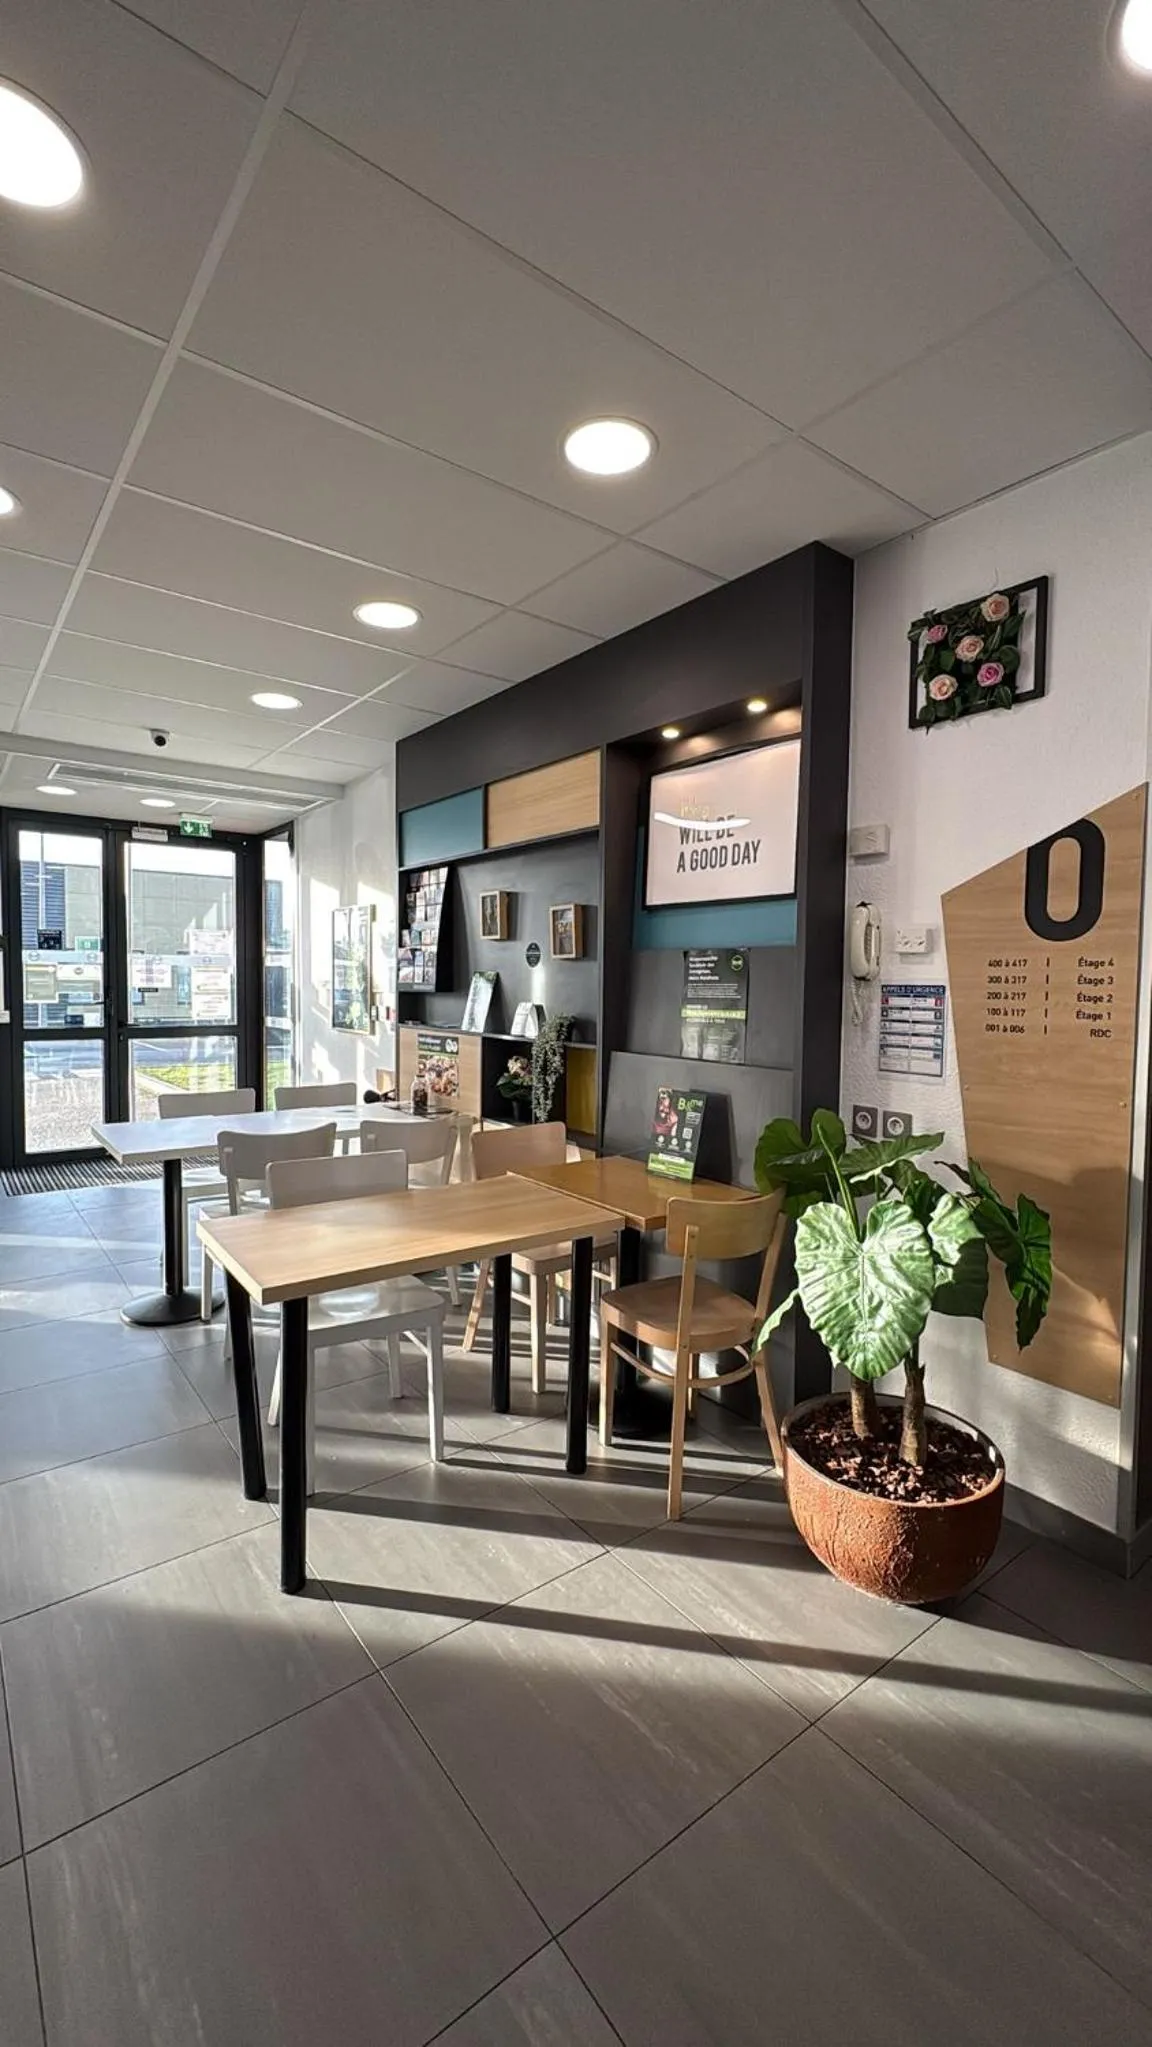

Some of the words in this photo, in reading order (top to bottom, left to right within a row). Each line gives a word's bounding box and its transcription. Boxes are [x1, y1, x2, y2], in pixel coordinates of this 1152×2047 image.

[679, 819, 712, 845] WILL
[676, 851, 686, 873] A
[690, 845, 728, 871] GOOD
[731, 839, 761, 866] DAY
[988, 959, 1002, 968] 400
[1012, 959, 1028, 968] 417
[1078, 956, 1106, 969] Étage
[1108, 958, 1115, 967] 4
[987, 975, 1002, 984] 300
[1011, 975, 1027, 984] 317
[1077, 974, 1105, 987] Étage
[1107, 976, 1114, 985] 3
[986, 991, 1001, 1000] 200
[1011, 992, 1027, 1000] 217
[1076, 991, 1104, 1004] Étage
[1106, 994, 1113, 1003] 2
[986, 1007, 1001, 1016] 100
[1011, 1008, 1026, 1017] 117
[1075, 1009, 1103, 1022] Étage
[1106, 1012, 1112, 1020] 1
[985, 1023, 1000, 1032] 001
[1009, 1024, 1025, 1033] 006
[1090, 1028, 1112, 1038] RDC
